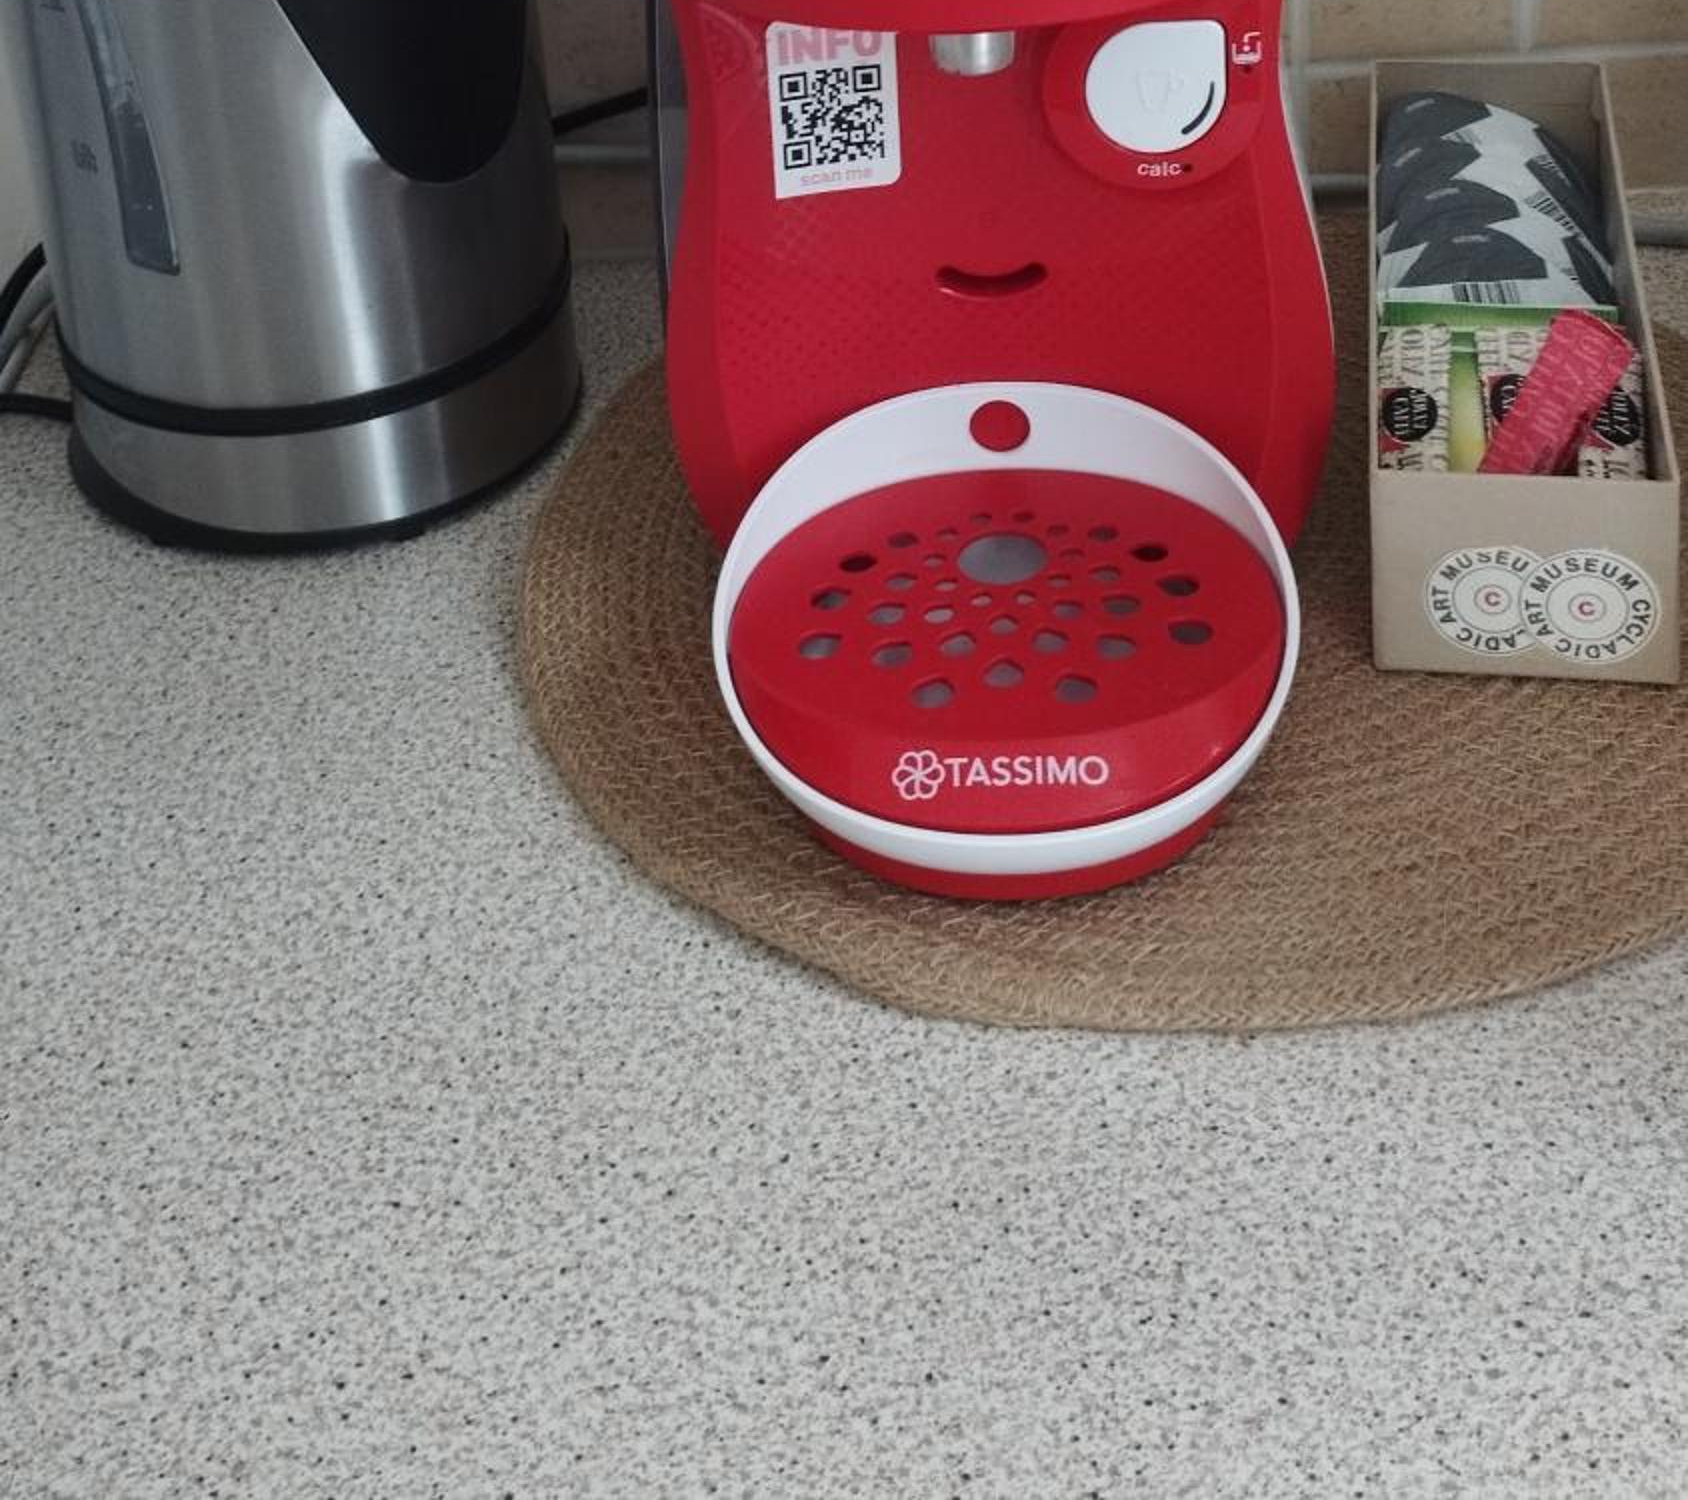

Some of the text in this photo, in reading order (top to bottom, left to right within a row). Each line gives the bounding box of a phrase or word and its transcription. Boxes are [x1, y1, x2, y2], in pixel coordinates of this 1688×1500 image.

[776, 29, 882, 65] INFO
[801, 168, 873, 186] scan me
[1137, 162, 1183, 177] calc
[1440, 550, 1530, 581] MUSEU
[1432, 586, 1457, 623] ART
[1525, 557, 1651, 659] CYCLADIC ART MUSEUM
[944, 756, 1109, 787] TASSIMO
